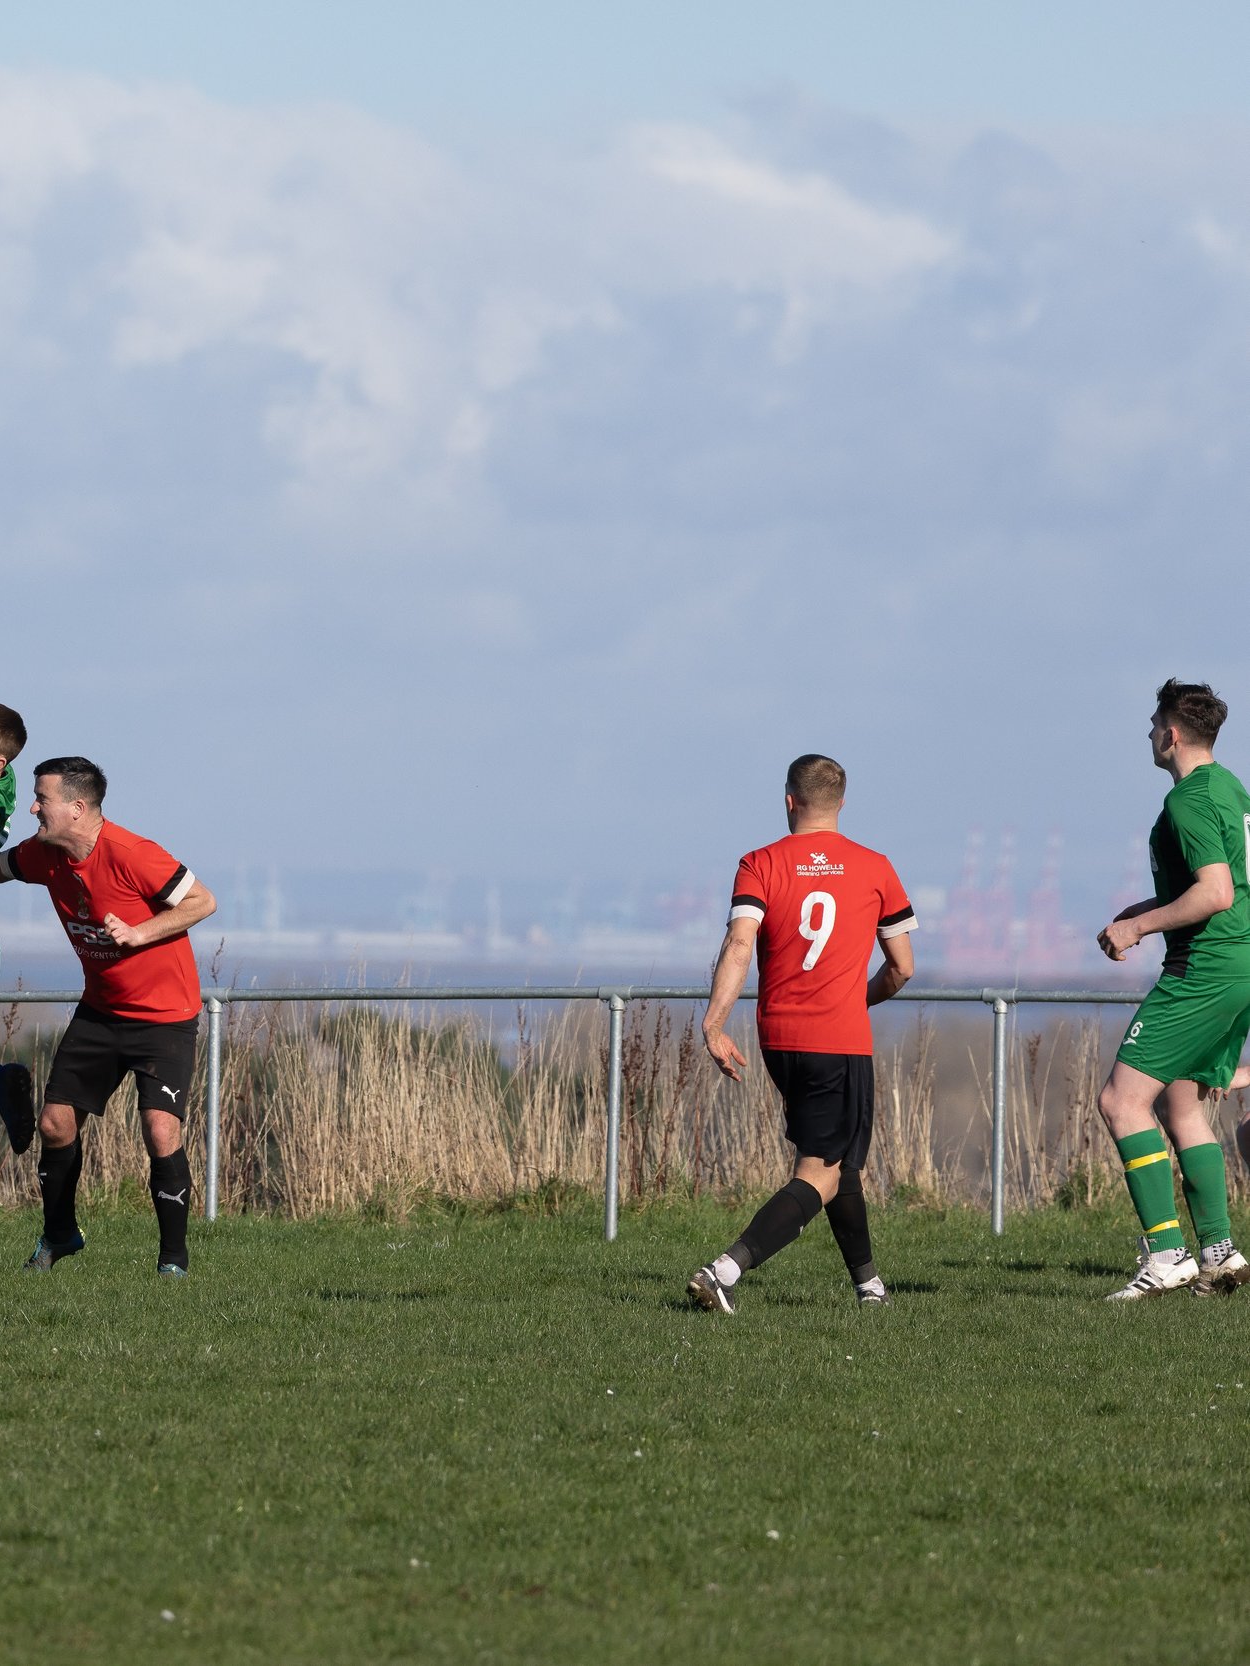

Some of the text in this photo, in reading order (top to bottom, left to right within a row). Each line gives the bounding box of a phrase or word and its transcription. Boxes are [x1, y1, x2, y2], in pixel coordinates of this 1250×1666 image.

[808, 863, 844, 871] HOWELLS
[798, 891, 836, 971] 9
[90, 951, 121, 959] CENTRE
[1130, 1021, 1143, 1037] 6
